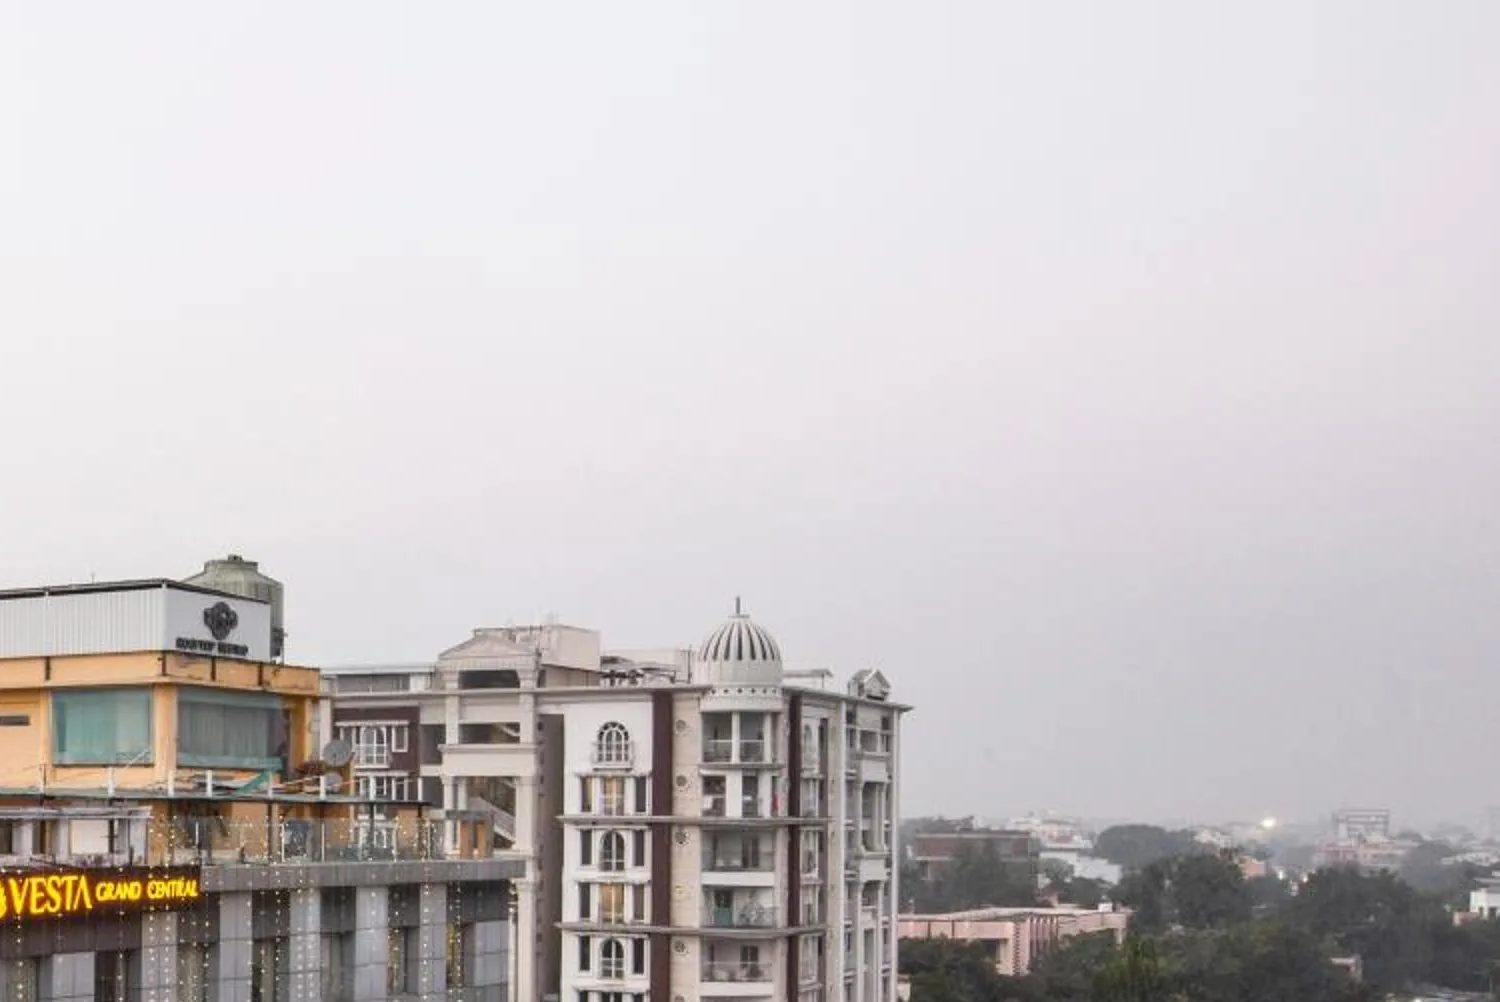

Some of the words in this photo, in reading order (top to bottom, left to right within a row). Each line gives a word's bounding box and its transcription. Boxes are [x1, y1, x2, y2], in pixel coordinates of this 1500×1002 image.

[10, 876, 92, 914] VESTA
[95, 881, 141, 901] GRAND
[147, 878, 198, 898] CENTRAL
